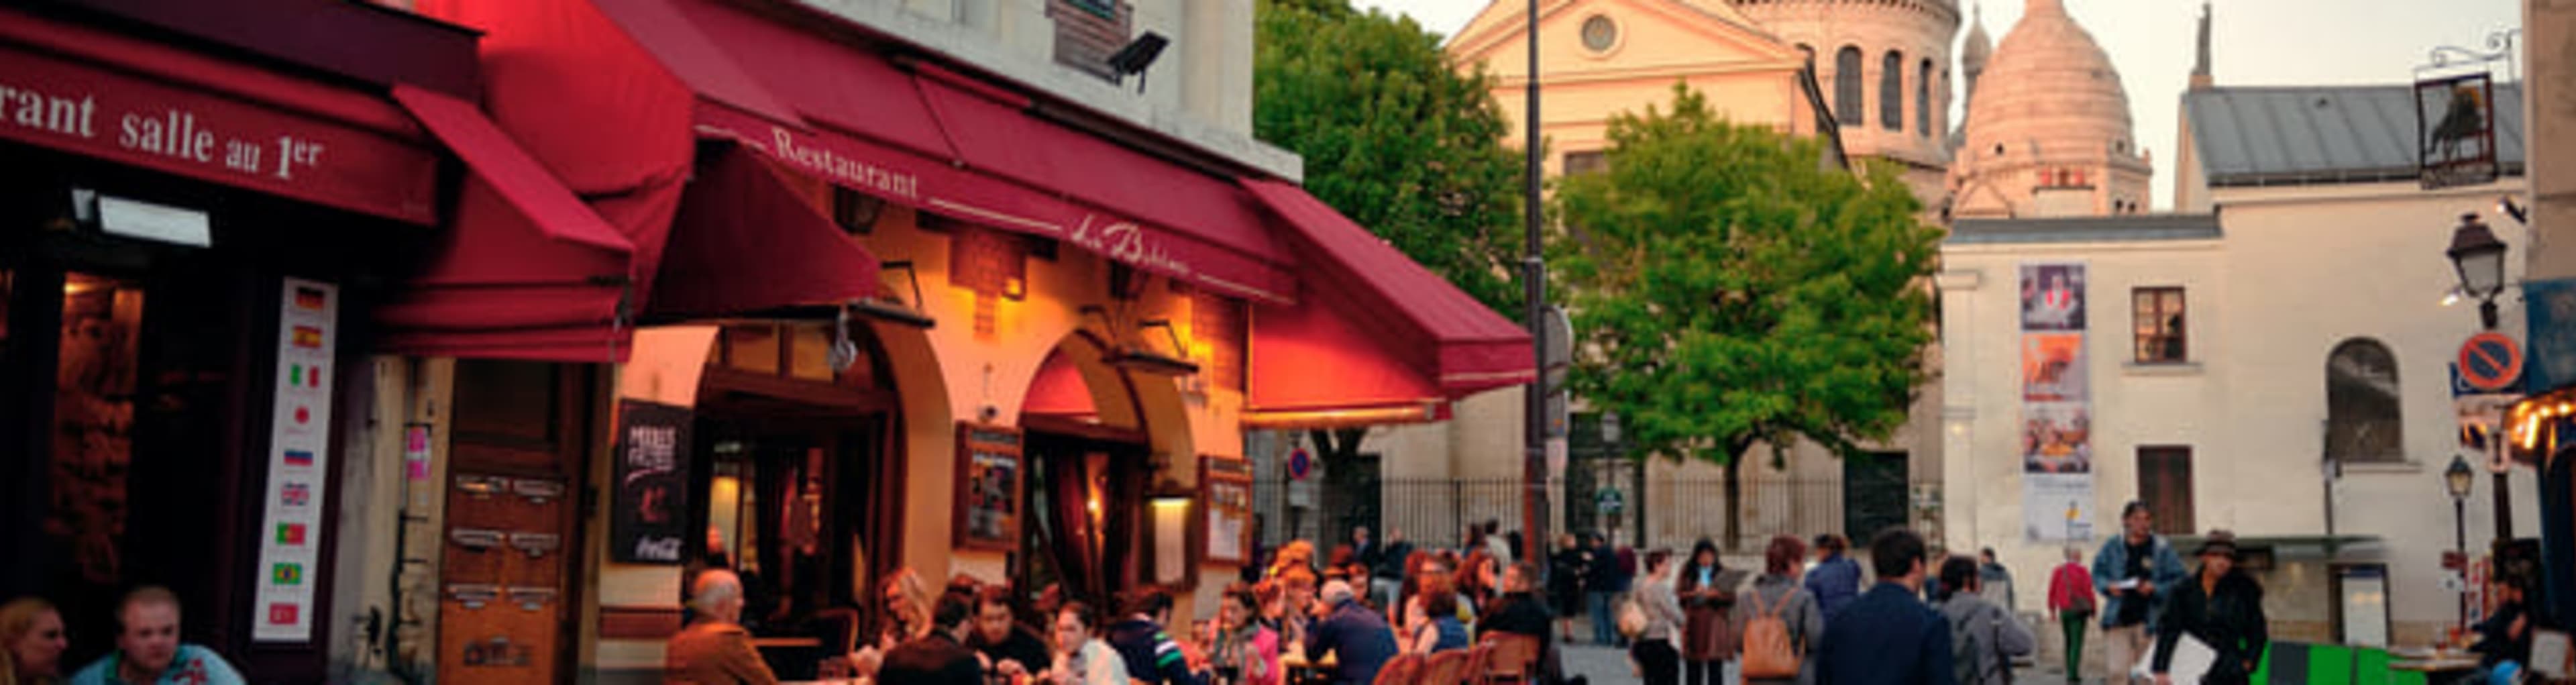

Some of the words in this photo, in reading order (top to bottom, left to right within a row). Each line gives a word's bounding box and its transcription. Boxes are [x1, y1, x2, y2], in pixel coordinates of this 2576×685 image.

[0, 85, 96, 138] rant
[119, 109, 214, 162] salle
[226, 138, 261, 173] au
[277, 136, 325, 180] 1er
[771, 125, 919, 199] Restaurant
